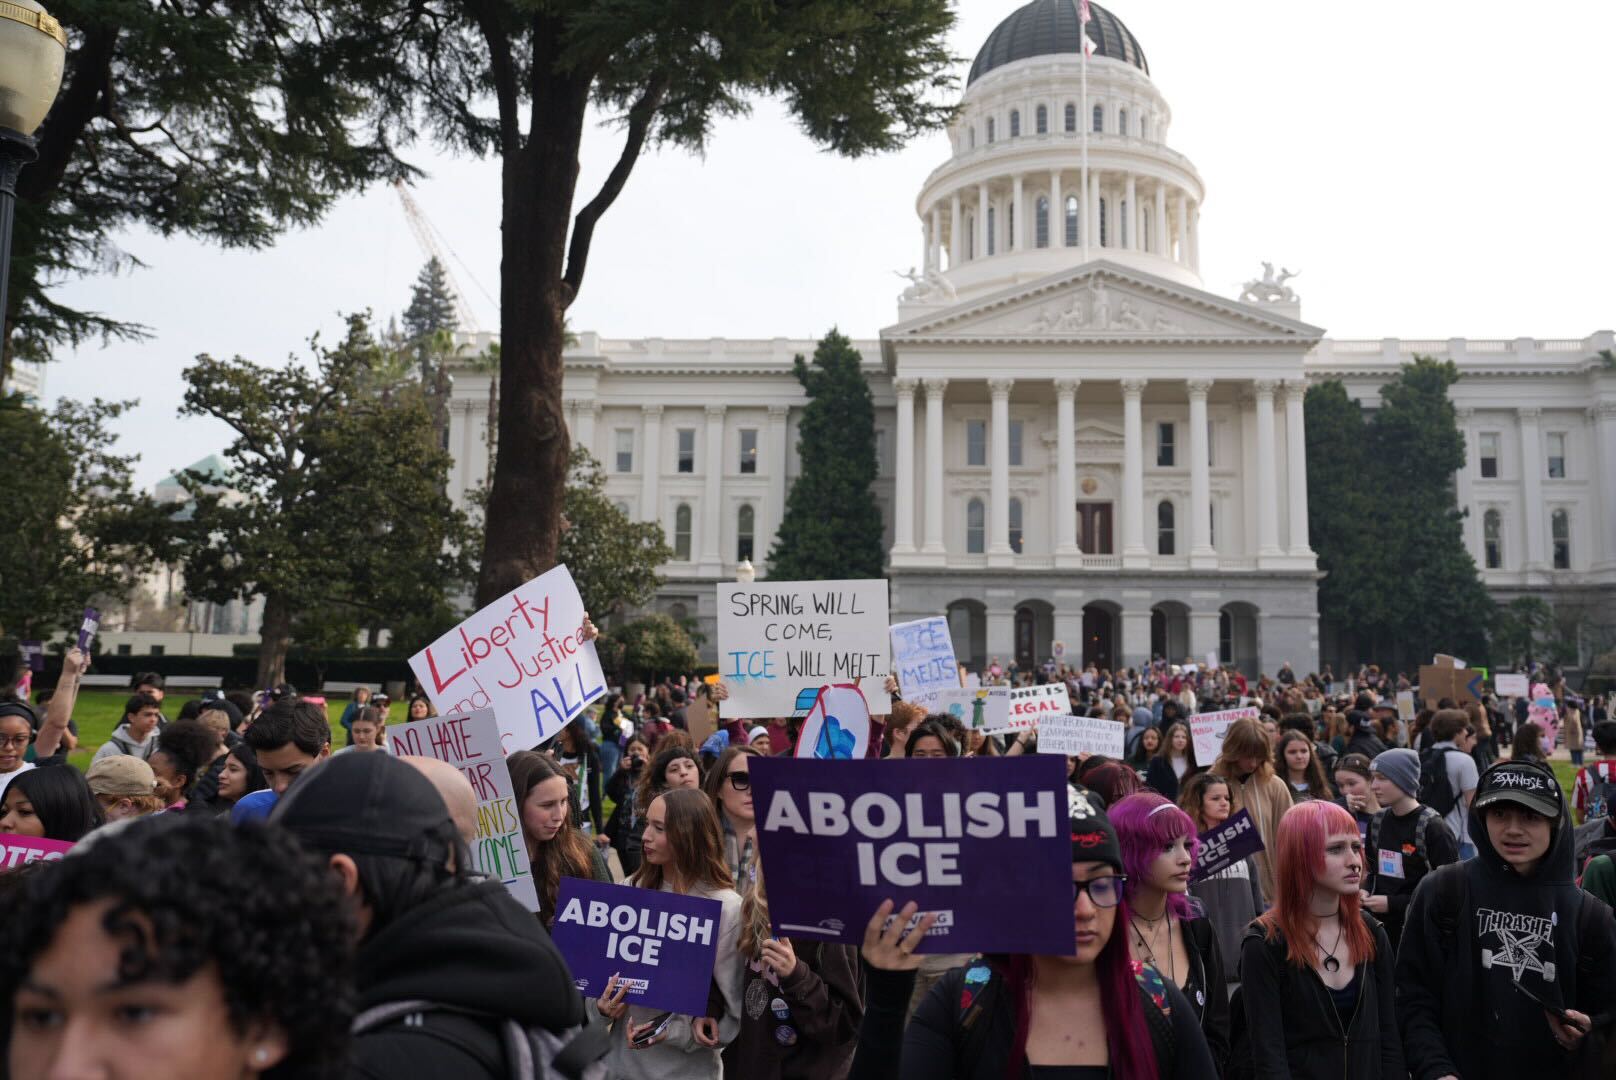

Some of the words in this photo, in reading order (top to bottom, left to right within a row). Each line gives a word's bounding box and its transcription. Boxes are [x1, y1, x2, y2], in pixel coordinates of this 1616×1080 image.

[730, 592, 804, 616] SPRING
[812, 592, 865, 615] WILL
[425, 594, 550, 695] Liberty
[765, 623, 833, 642] COME,
[497, 626, 586, 689] Justice
[725, 651, 777, 680] ICE
[787, 652, 826, 677] WILL
[530, 663, 604, 738] ALL
[1045, 686, 1064, 695] IS
[392, 728, 424, 757] NO
[426, 717, 483, 763] HATE
[458, 763, 499, 801] AR
[764, 790, 1057, 839] ABOLISH
[857, 842, 962, 887] ICE
[1198, 844, 1230, 867] ICE
[558, 897, 714, 946] ABOLISH
[1476, 907, 1555, 949] THRASHE
[606, 932, 662, 967] ICE
